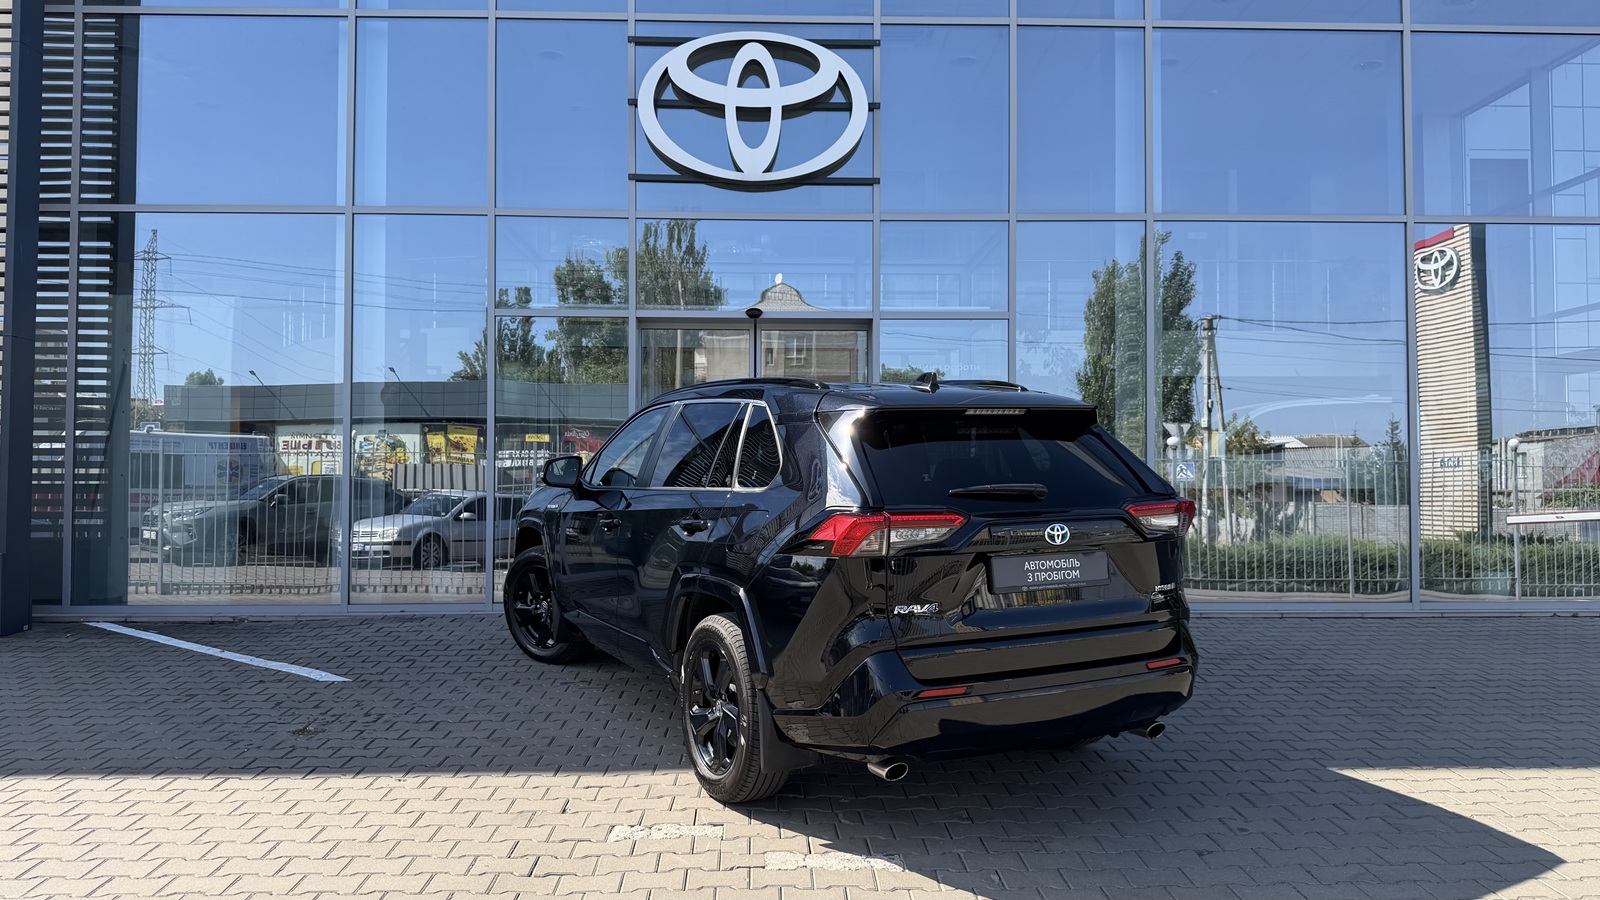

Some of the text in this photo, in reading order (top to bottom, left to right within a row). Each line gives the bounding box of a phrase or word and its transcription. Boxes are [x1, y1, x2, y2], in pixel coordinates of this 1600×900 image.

[1024, 559, 1081, 571] АВТОМОБІЛЬ
[1027, 570, 1080, 583] З ПРОБІГОМ
[894, 603, 939, 615] RAV4
